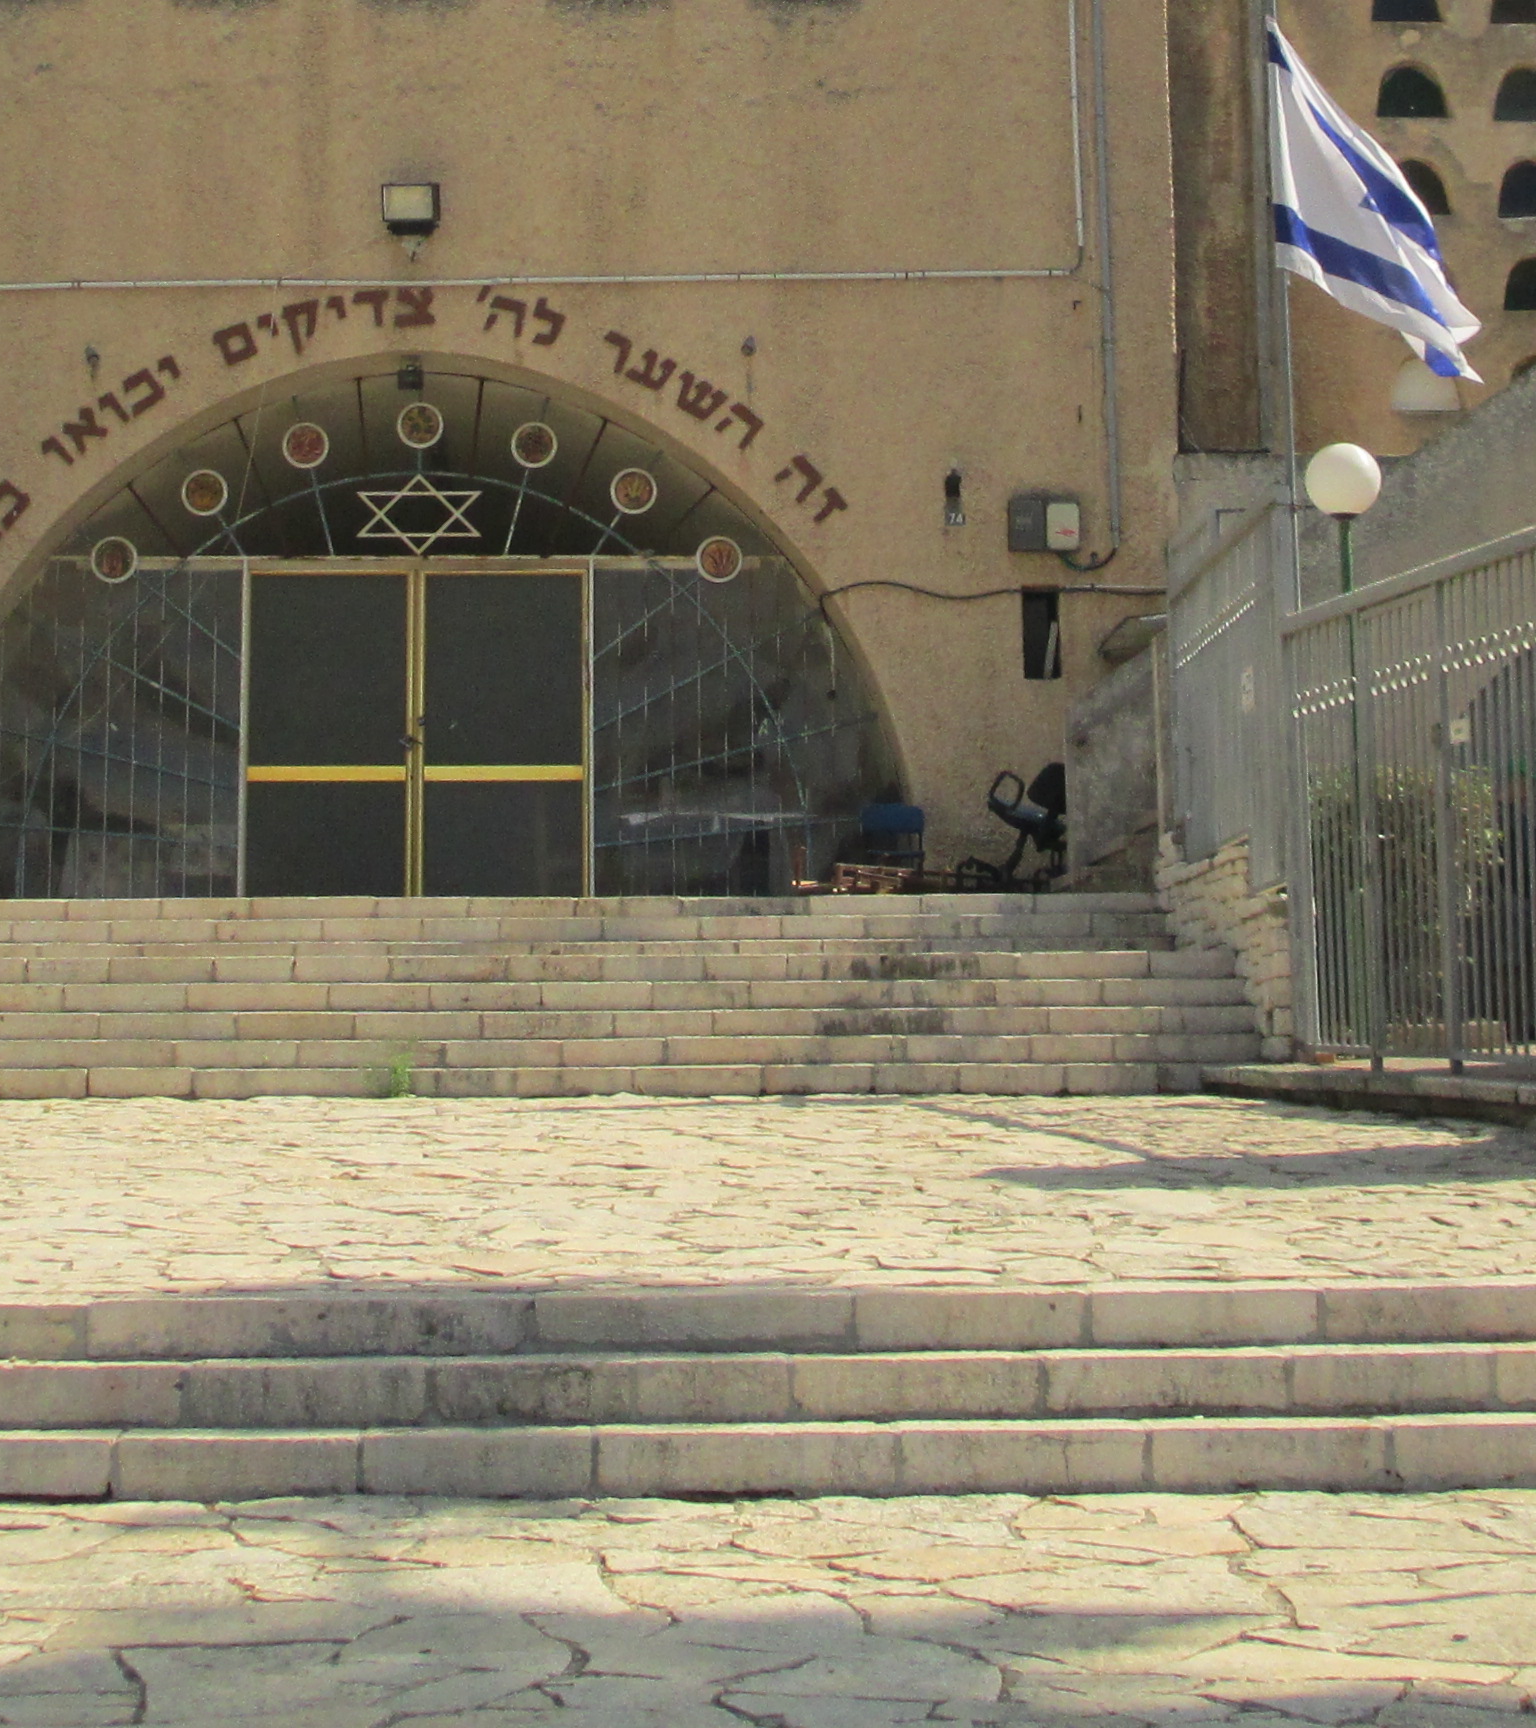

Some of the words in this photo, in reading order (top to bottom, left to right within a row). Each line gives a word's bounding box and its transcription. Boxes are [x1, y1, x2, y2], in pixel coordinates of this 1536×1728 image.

[212, 285, 437, 367] צדיקים
[40, 355, 182, 466] יבואו
[602, 330, 765, 452] השער
[775, 454, 849, 526] זה
